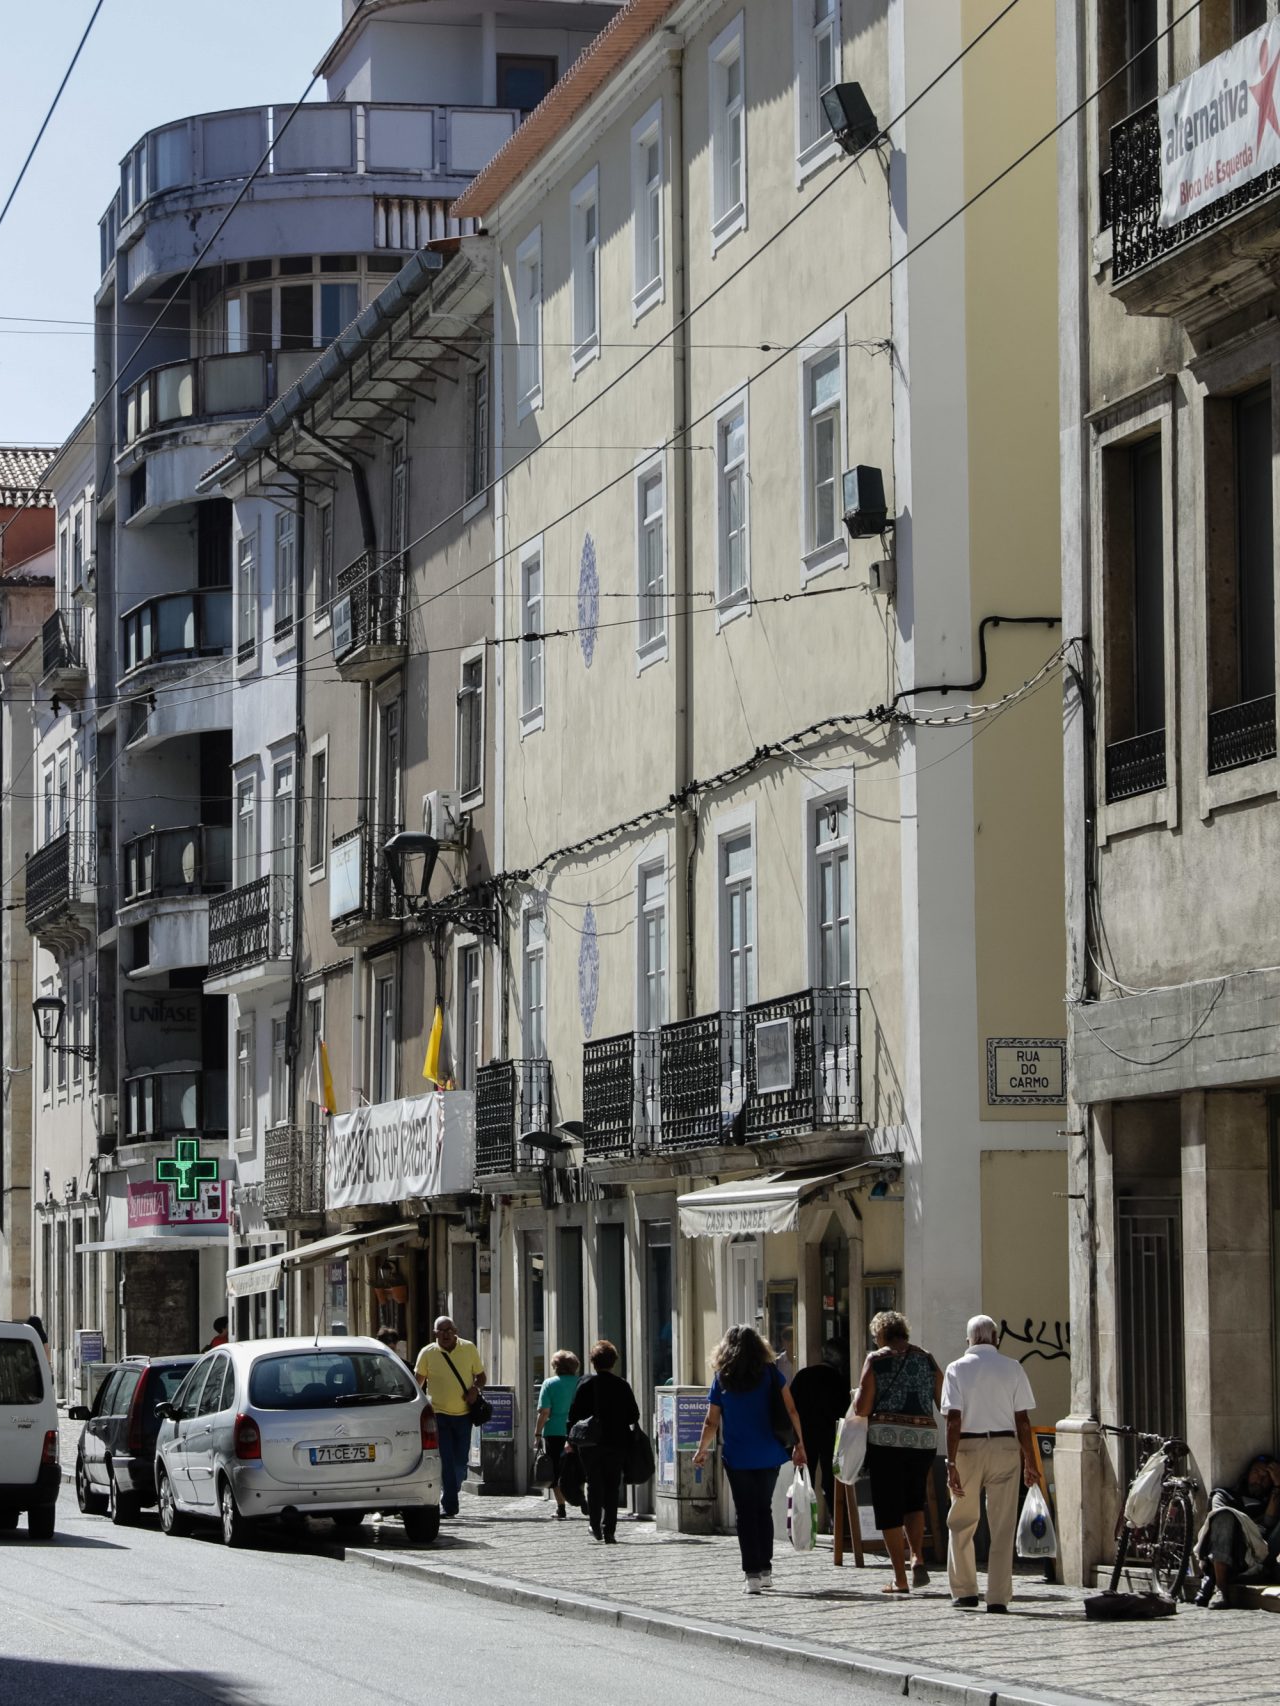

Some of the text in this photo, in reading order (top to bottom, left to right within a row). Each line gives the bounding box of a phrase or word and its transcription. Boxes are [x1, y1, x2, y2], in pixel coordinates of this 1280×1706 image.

[1166, 79, 1249, 166] alternativa
[1180, 142, 1253, 206] Bloco de Esquerda
[1016, 1050, 1041, 1062] RUA
[1021, 1063, 1037, 1075] DO
[1009, 1076, 1049, 1088] CARMO
[382, 1123, 399, 1182] POR
[705, 1211, 726, 1231] CASA
[739, 1209, 767, 1230] ISABEL
